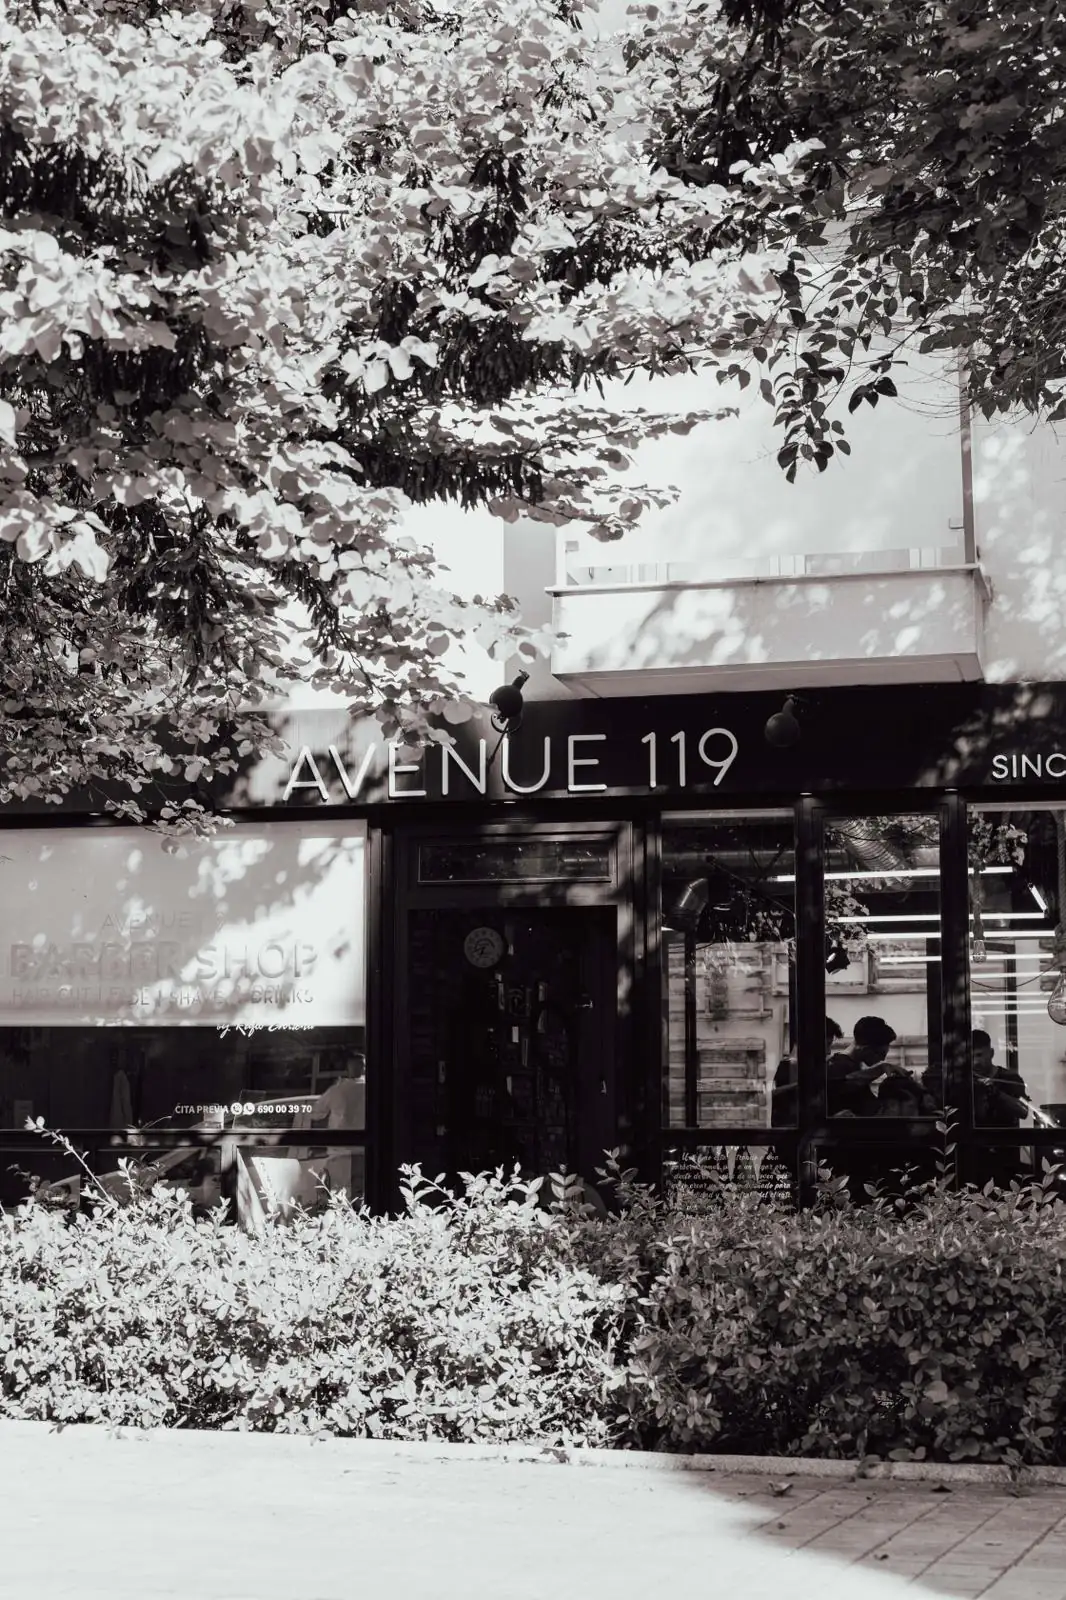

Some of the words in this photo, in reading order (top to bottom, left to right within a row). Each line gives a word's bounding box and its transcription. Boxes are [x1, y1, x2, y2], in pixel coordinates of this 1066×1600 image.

[282, 733, 608, 801] AVENUE
[641, 727, 738, 788] 119
[196, 941, 319, 979] SHOP
[175, 1105, 195, 1114] CITA
[197, 1105, 229, 1114] PREVIA
[257, 1105, 274, 1113] 690
[275, 1105, 287, 1113] 00
[288, 1105, 300, 1113] 39
[301, 1105, 312, 1113] 70
